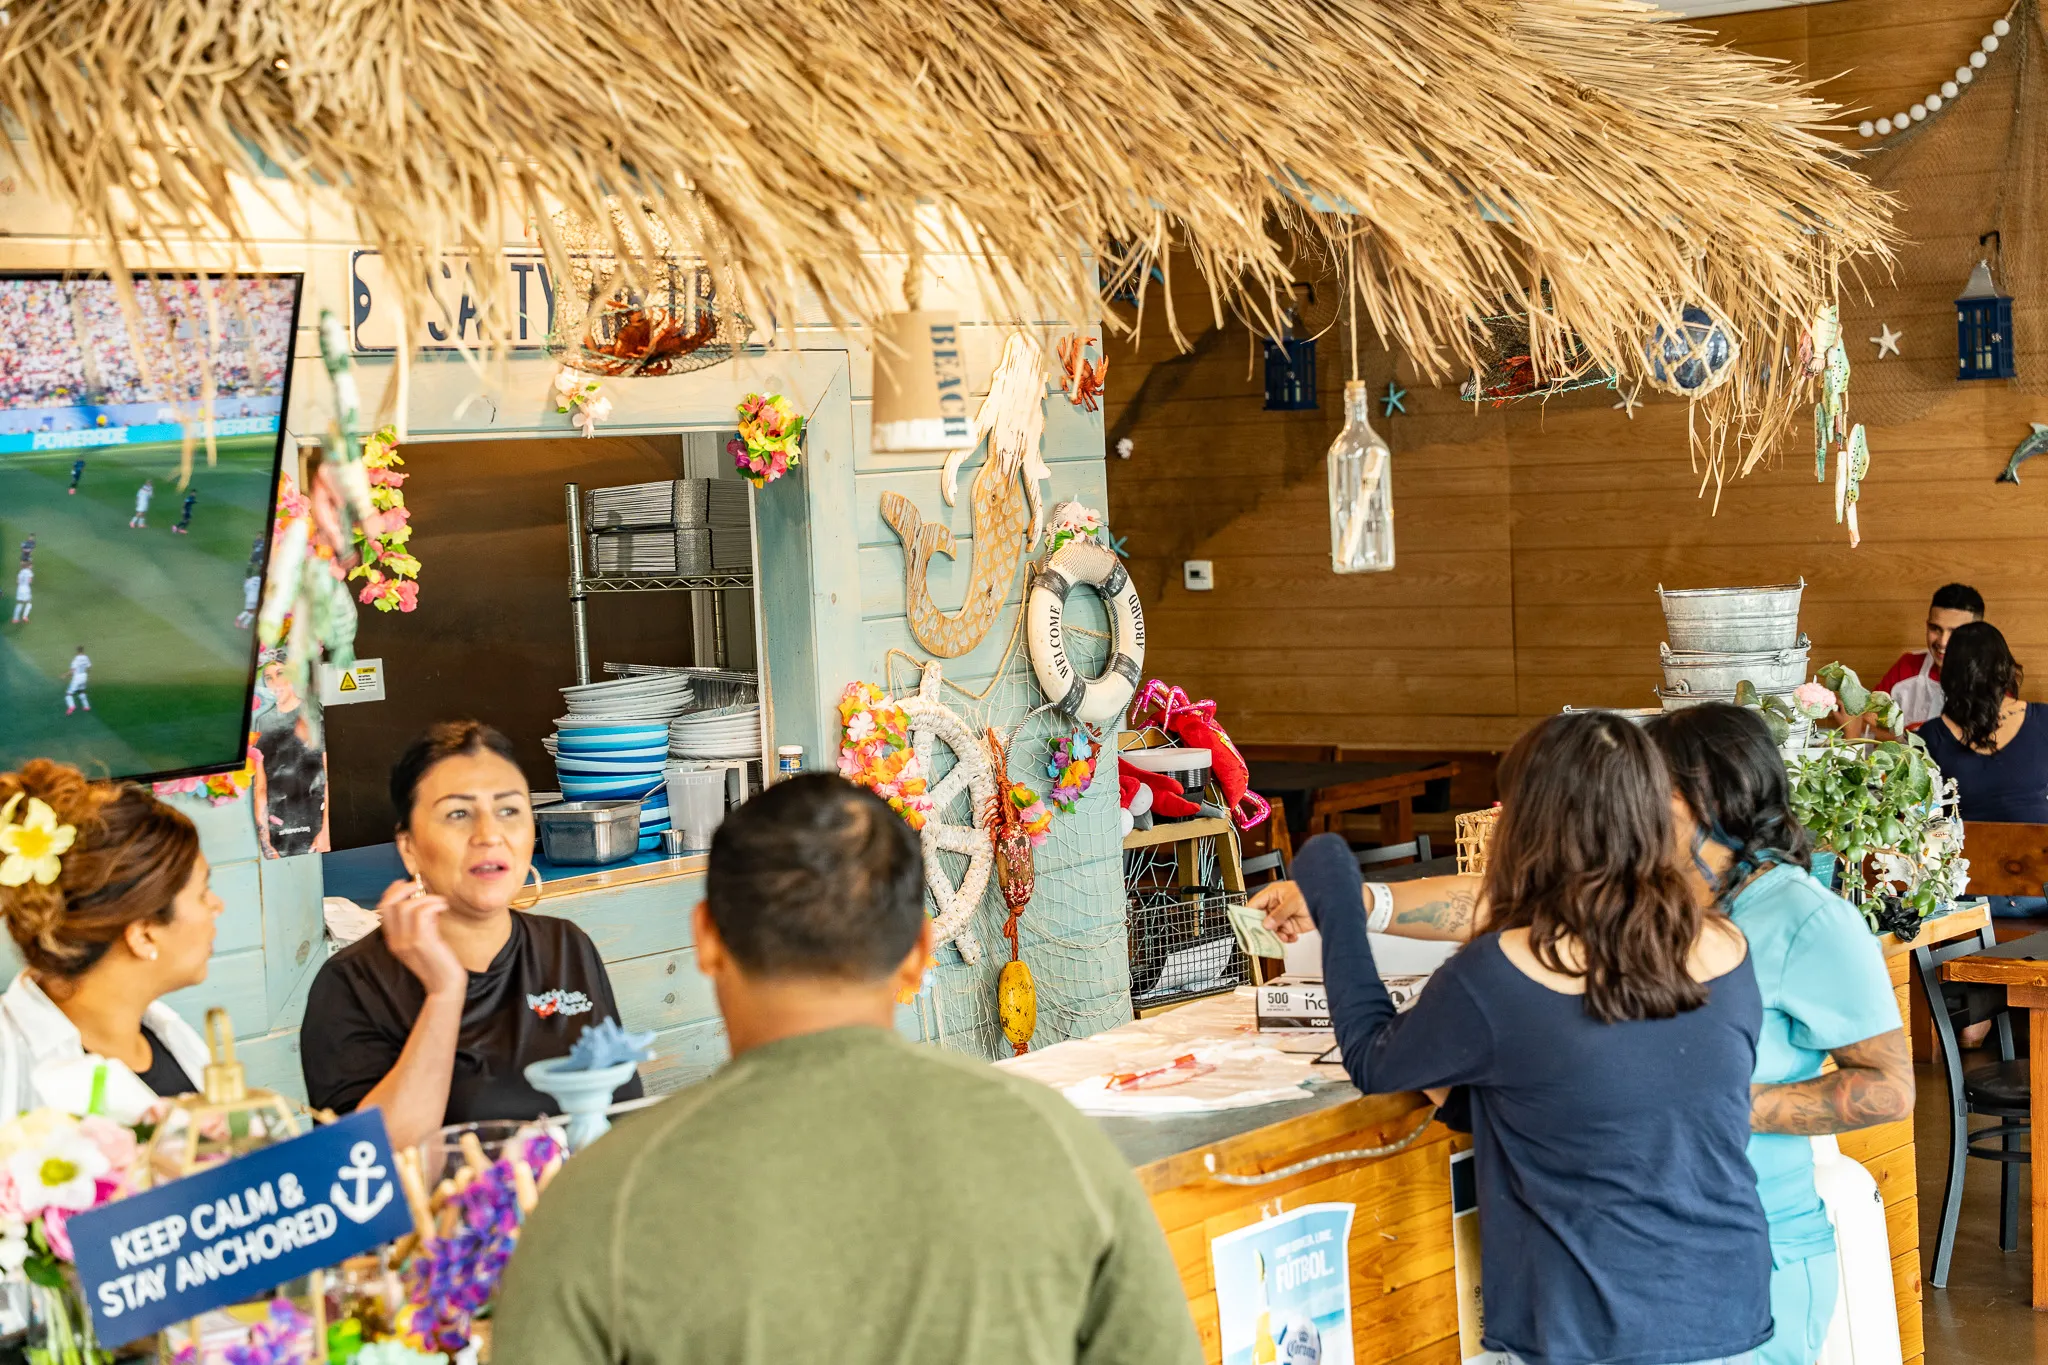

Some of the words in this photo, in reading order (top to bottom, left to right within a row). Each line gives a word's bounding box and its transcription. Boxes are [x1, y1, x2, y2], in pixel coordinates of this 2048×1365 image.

[930, 325, 967, 436] BEACH
[33, 427, 128, 450] POWERADE
[1049, 605, 1069, 679] WELCOME
[1128, 594, 1145, 650] ABOARD
[1267, 992, 1289, 1004] 500
[1310, 1019, 1330, 1027] POLY
[110, 1214, 187, 1270] KEEP
[190, 1181, 278, 1240] CALM
[277, 1172, 306, 1209] &
[97, 1264, 167, 1318] STAY
[176, 1203, 338, 1293] ANCHORED
